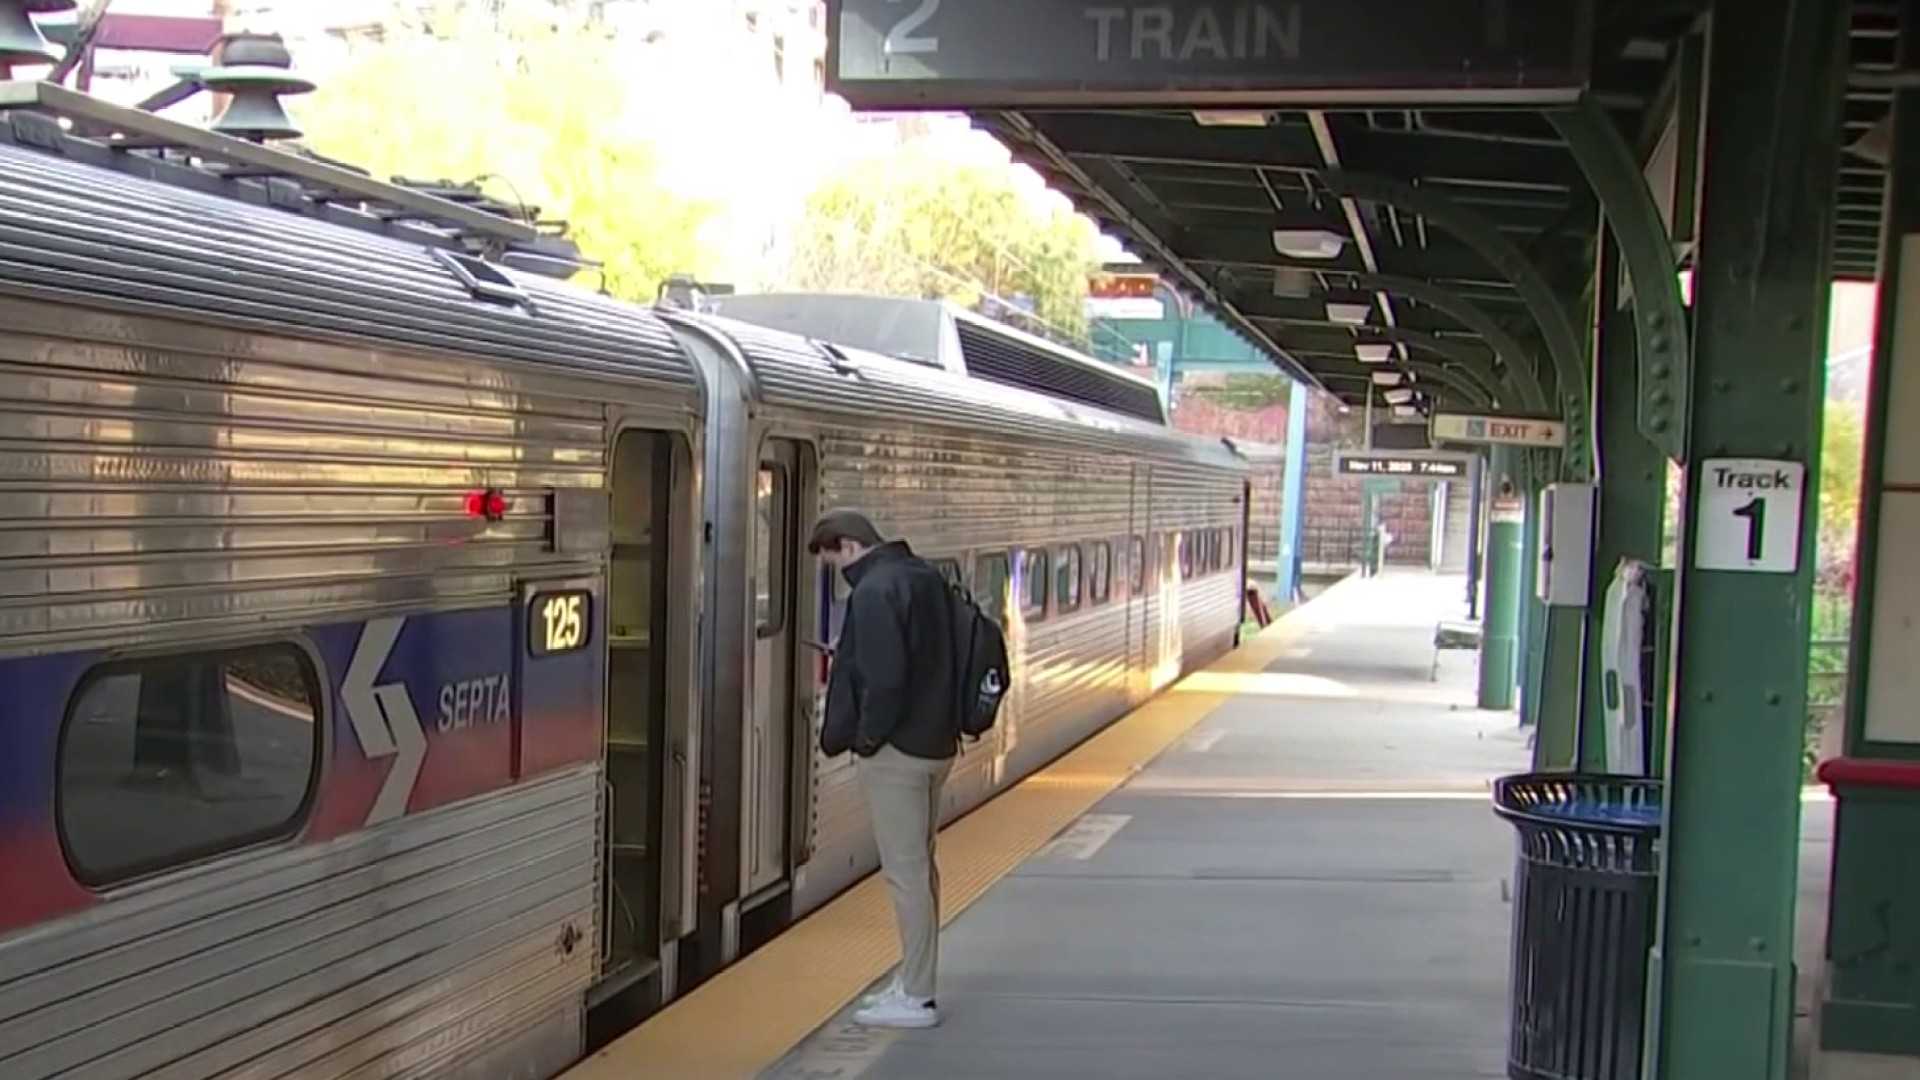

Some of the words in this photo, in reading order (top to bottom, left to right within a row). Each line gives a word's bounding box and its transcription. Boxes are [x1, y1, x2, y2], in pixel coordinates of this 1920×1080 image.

[1084, 4, 1300, 61] TRAIN
[1490, 423, 1531, 440] EXIT
[1713, 468, 1789, 488] Track
[1733, 497, 1765, 559] 1
[543, 596, 581, 650] 125
[437, 673, 512, 733] SEPTA
